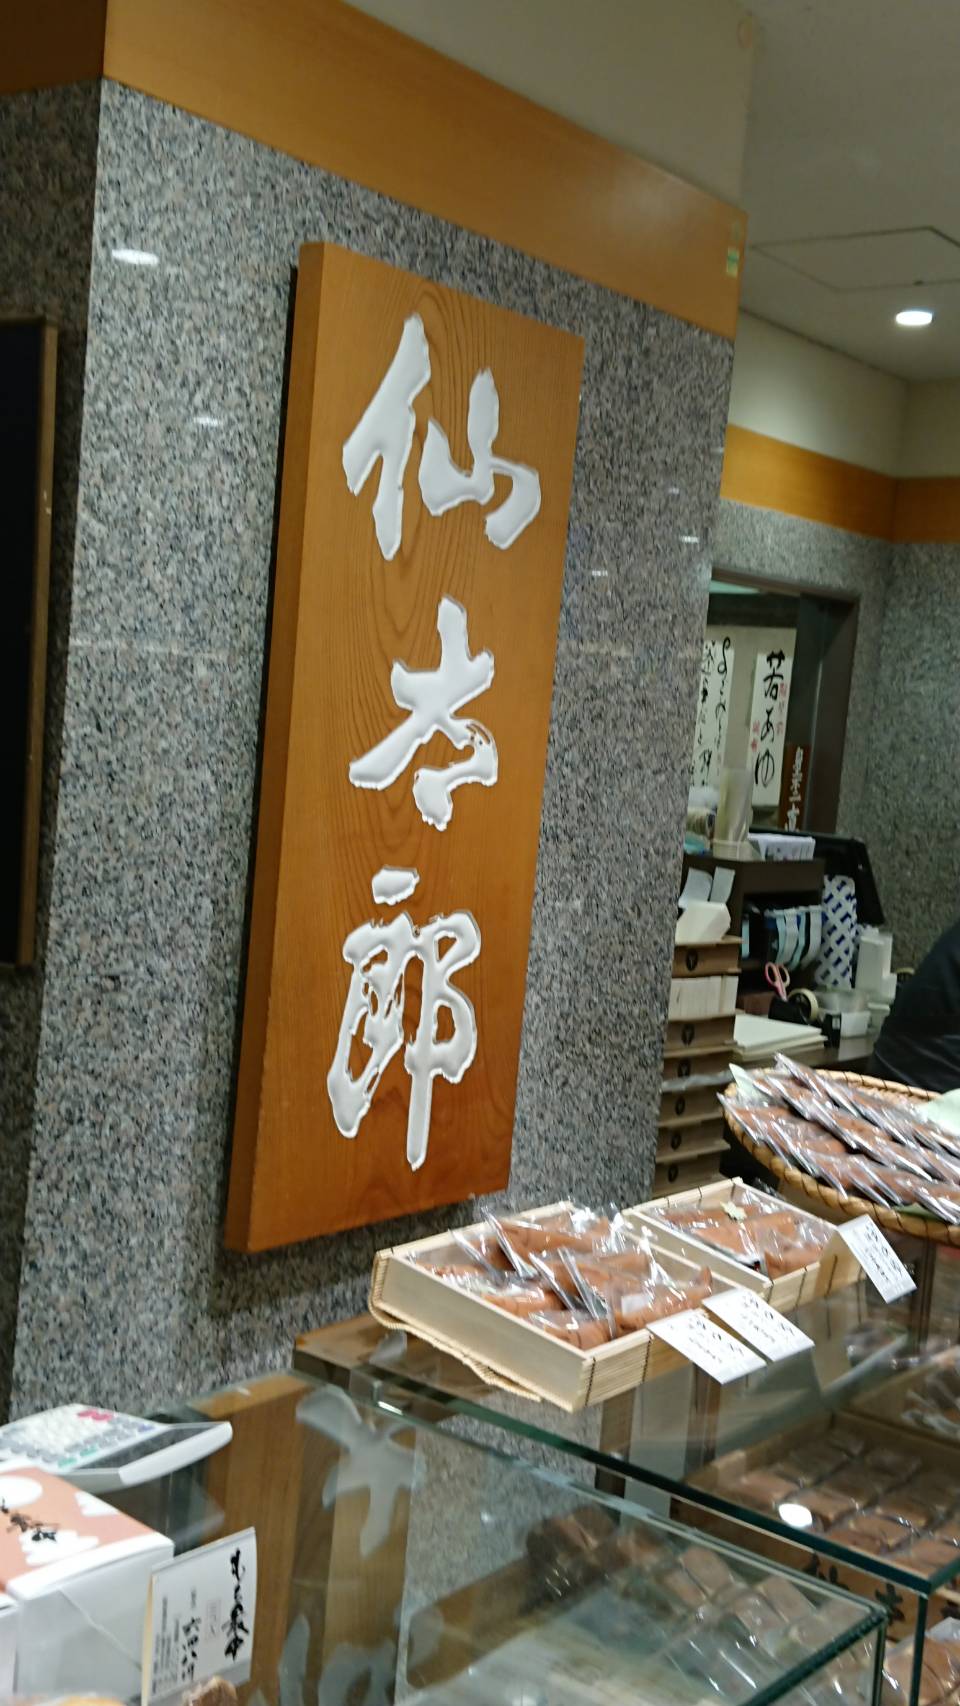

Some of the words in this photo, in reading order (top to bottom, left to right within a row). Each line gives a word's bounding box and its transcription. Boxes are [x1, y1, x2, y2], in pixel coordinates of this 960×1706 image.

[326, 313, 542, 1174] 仙太郎
[755, 648, 785, 789] 若あゆ
